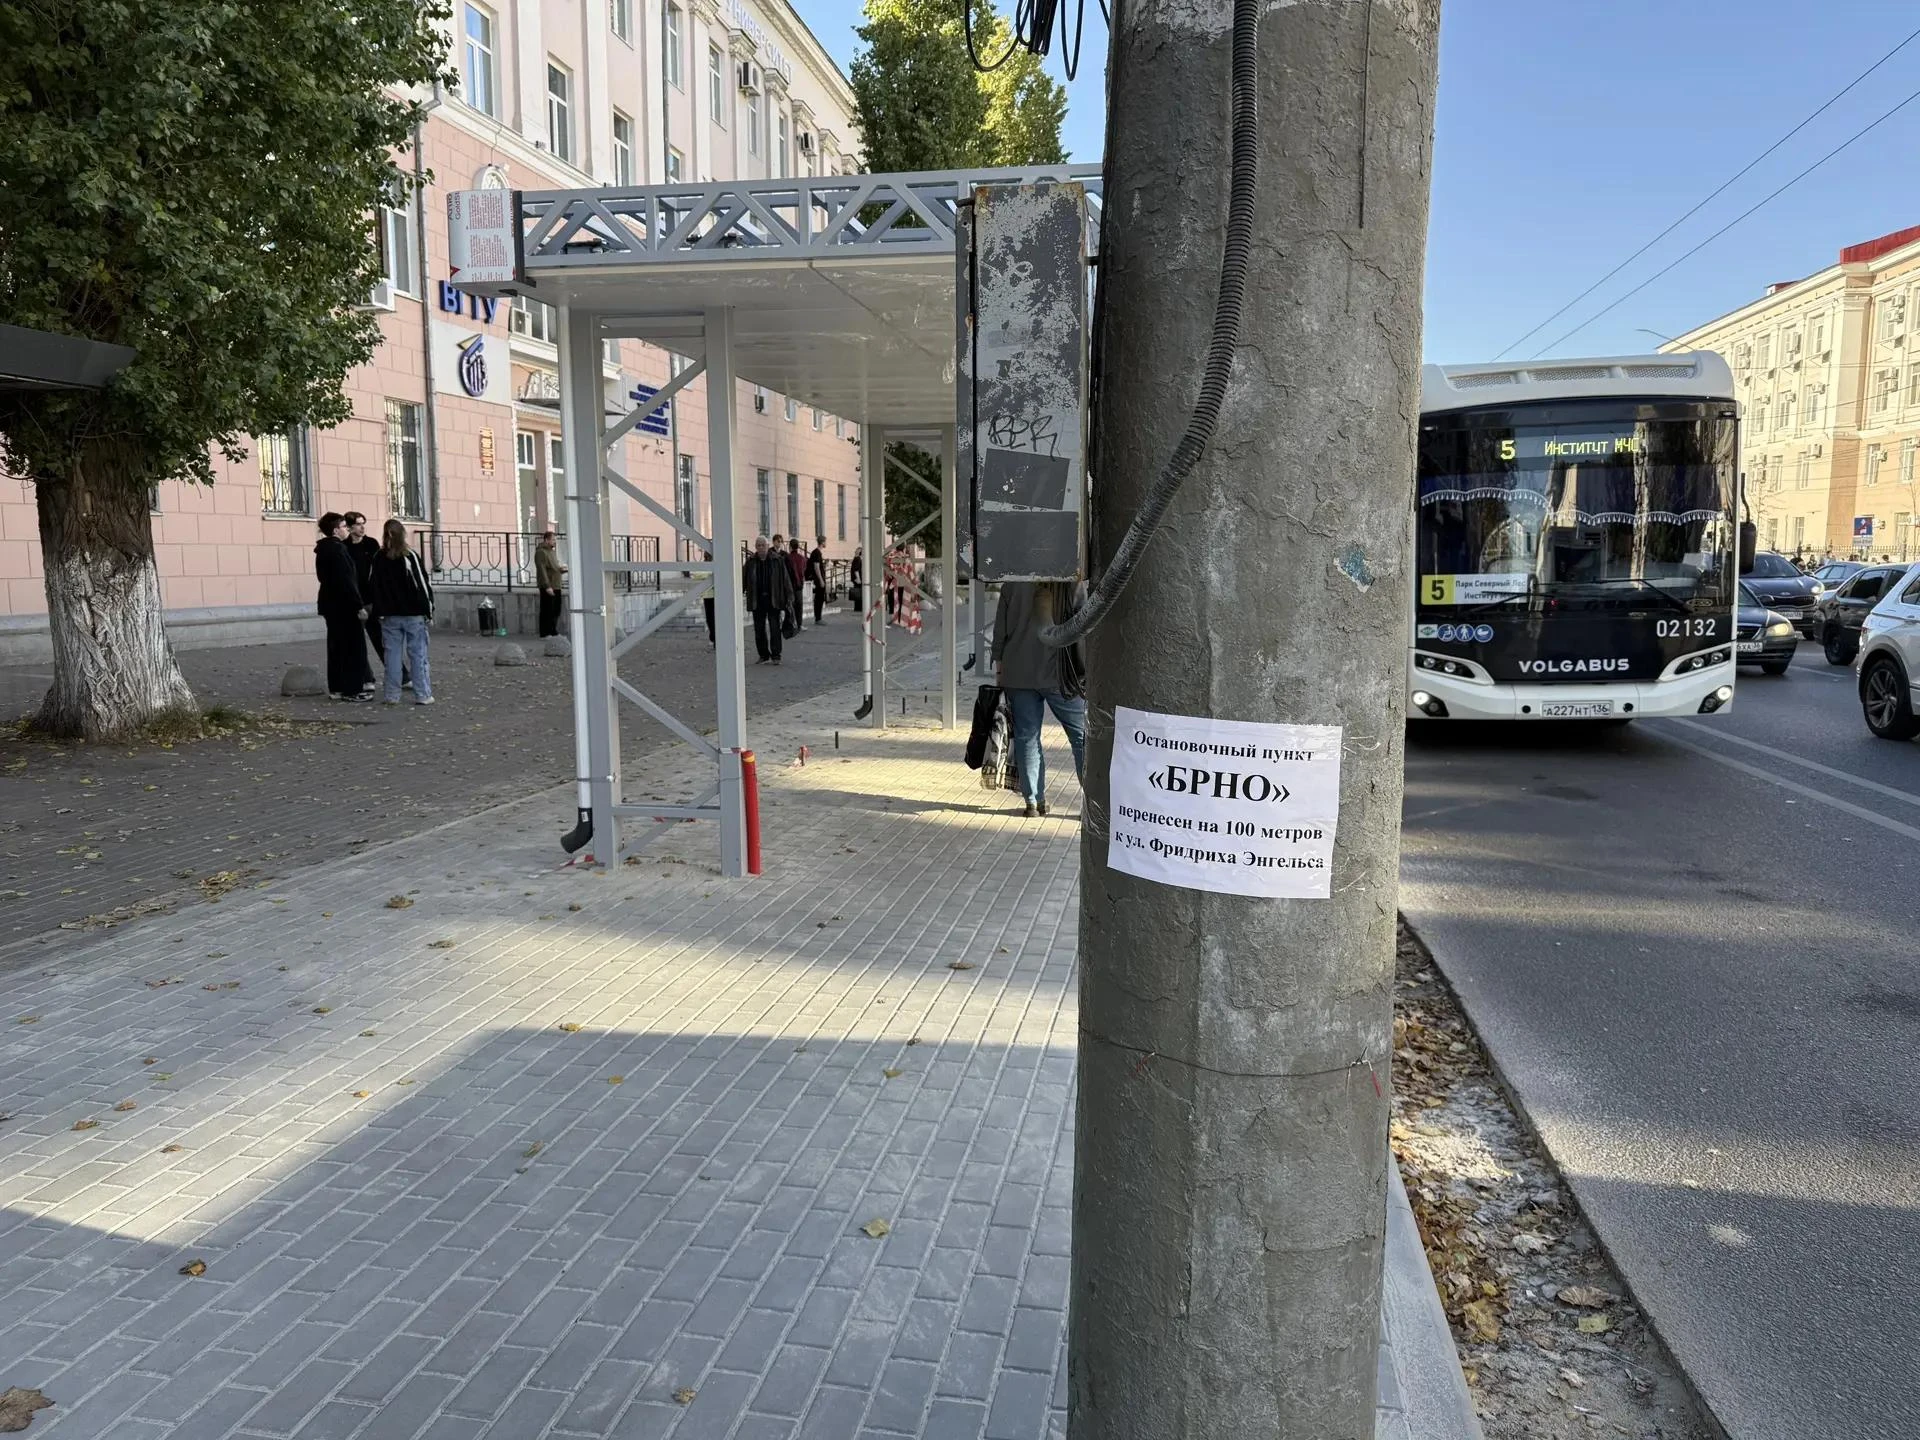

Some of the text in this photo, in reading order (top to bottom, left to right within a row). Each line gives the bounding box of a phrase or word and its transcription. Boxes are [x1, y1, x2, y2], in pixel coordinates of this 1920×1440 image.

[1500, 440, 1516, 460] 5
[1431, 580, 1445, 601] 5
[1475, 580, 1510, 588] Северный
[1656, 619, 1716, 637] 02132
[1518, 659, 1629, 673] VOLGABUS
[1591, 704, 1608, 713] 136
[1134, 730, 1315, 763] Остановочный пункт
[1148, 764, 1290, 803] «БРНО»
[1118, 804, 1322, 842] перенесен на 100 метров
[1115, 831, 1324, 869] к ул. Фридриха Энгельса
